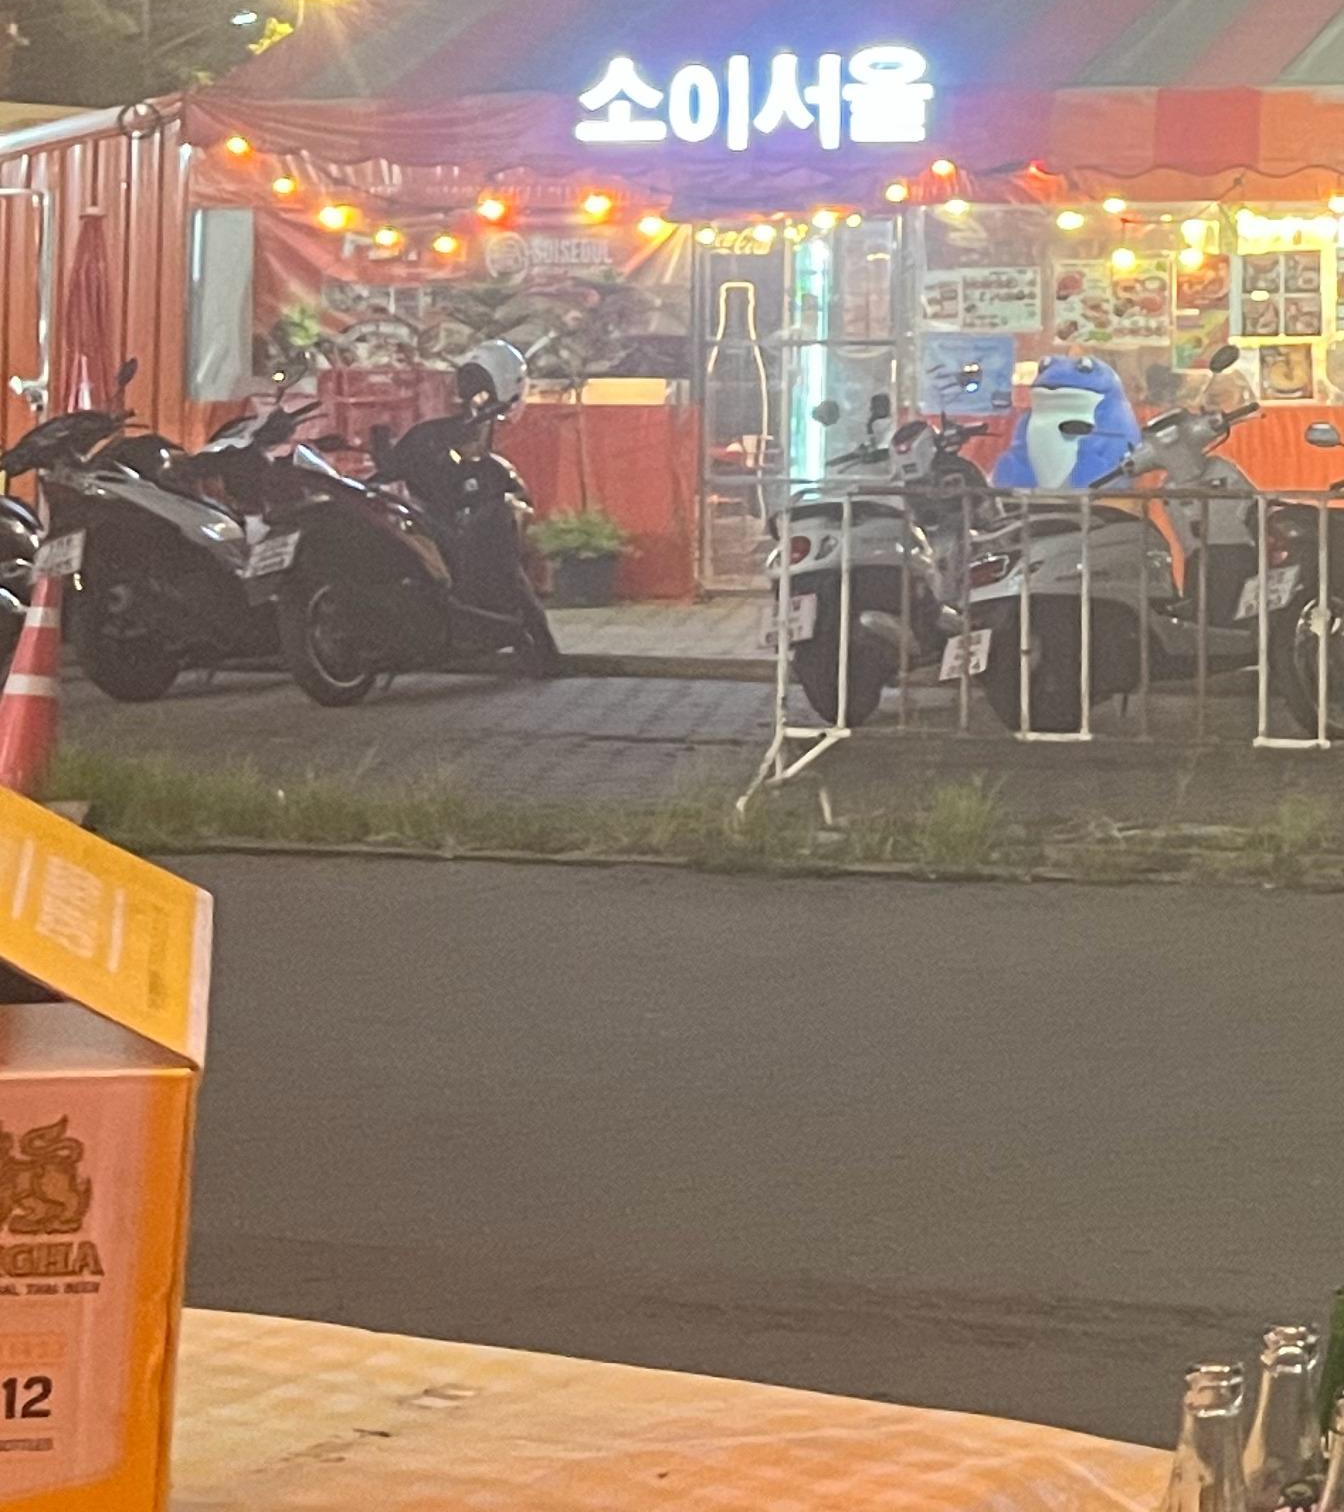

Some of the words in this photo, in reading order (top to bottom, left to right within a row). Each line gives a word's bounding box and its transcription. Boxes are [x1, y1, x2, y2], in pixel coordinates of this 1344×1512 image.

[574, 45, 934, 152] 소이서울
[0, 1241, 104, 1278] GHA
[2, 1375, 53, 1420] 12
